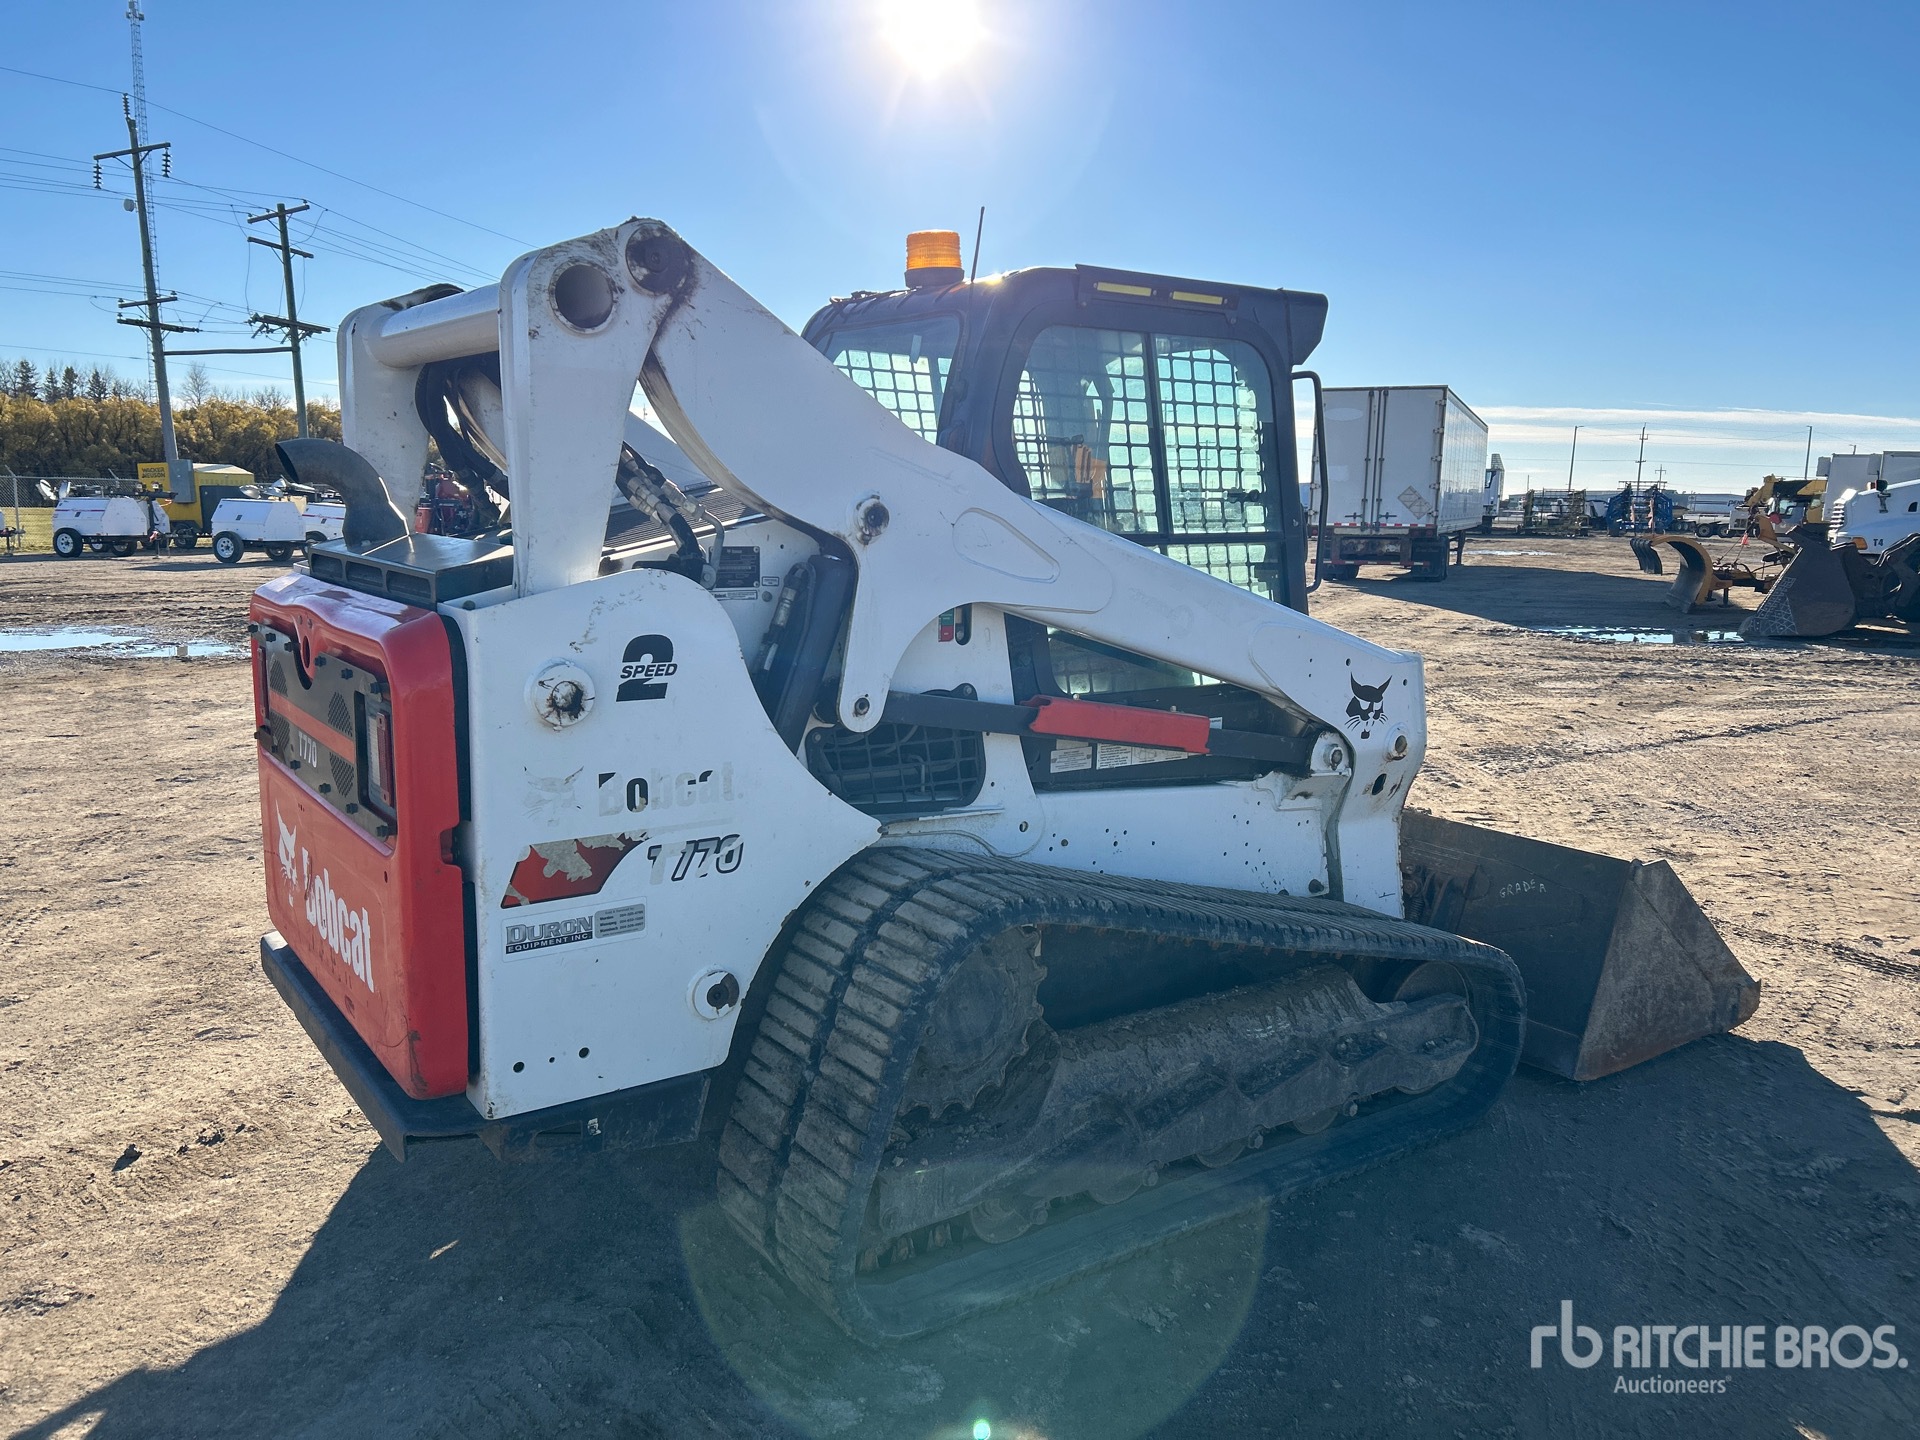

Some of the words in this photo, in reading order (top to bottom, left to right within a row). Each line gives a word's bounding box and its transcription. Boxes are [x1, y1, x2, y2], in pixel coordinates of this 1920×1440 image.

[1873, 538, 1884, 546] T4
[615, 634, 674, 702] 2
[620, 663, 678, 679] SPEED
[298, 731, 318, 768] T770
[506, 915, 593, 945] DURON
[508, 936, 569, 953] EQUIPMENT
